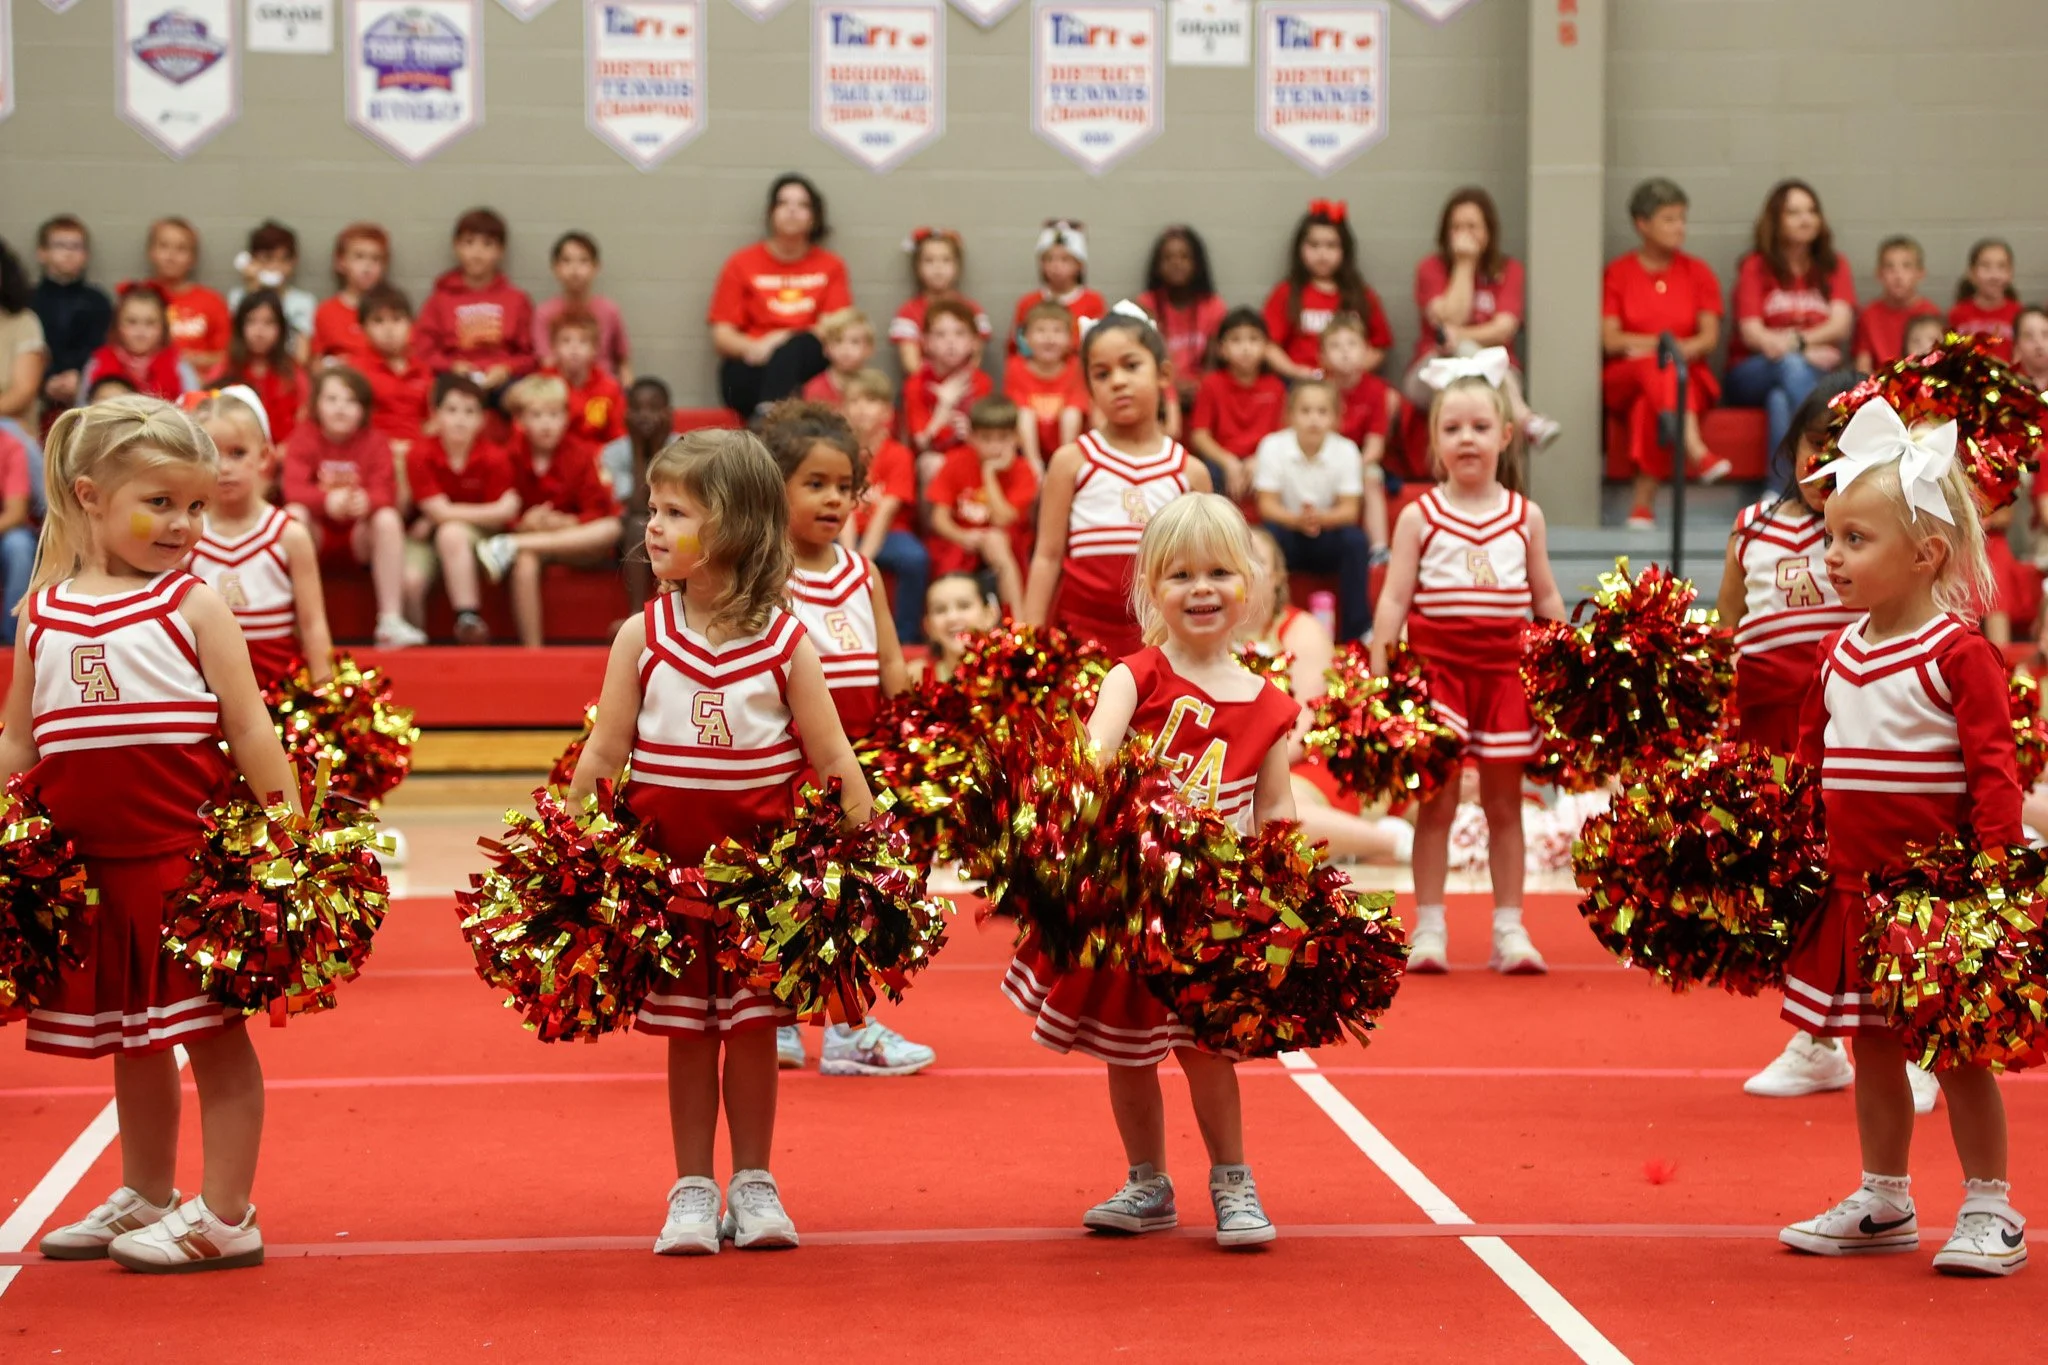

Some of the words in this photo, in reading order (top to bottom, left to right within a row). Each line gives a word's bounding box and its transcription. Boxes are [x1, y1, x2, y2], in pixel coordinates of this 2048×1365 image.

[598, 61, 694, 78] DISTRICT
[1050, 66, 1146, 82] DISTRICT
[1275, 68, 1370, 83] DISTRICT
[602, 81, 693, 97] TENNIS
[1050, 86, 1147, 102] TENNIS
[1274, 88, 1372, 103] TENNIS
[1467, 550, 1498, 588] CA
[1776, 556, 1824, 608] CA
[824, 610, 862, 651] CA
[71, 644, 120, 703] CA
[691, 691, 733, 747] CA
[1147, 695, 1228, 811] CA
